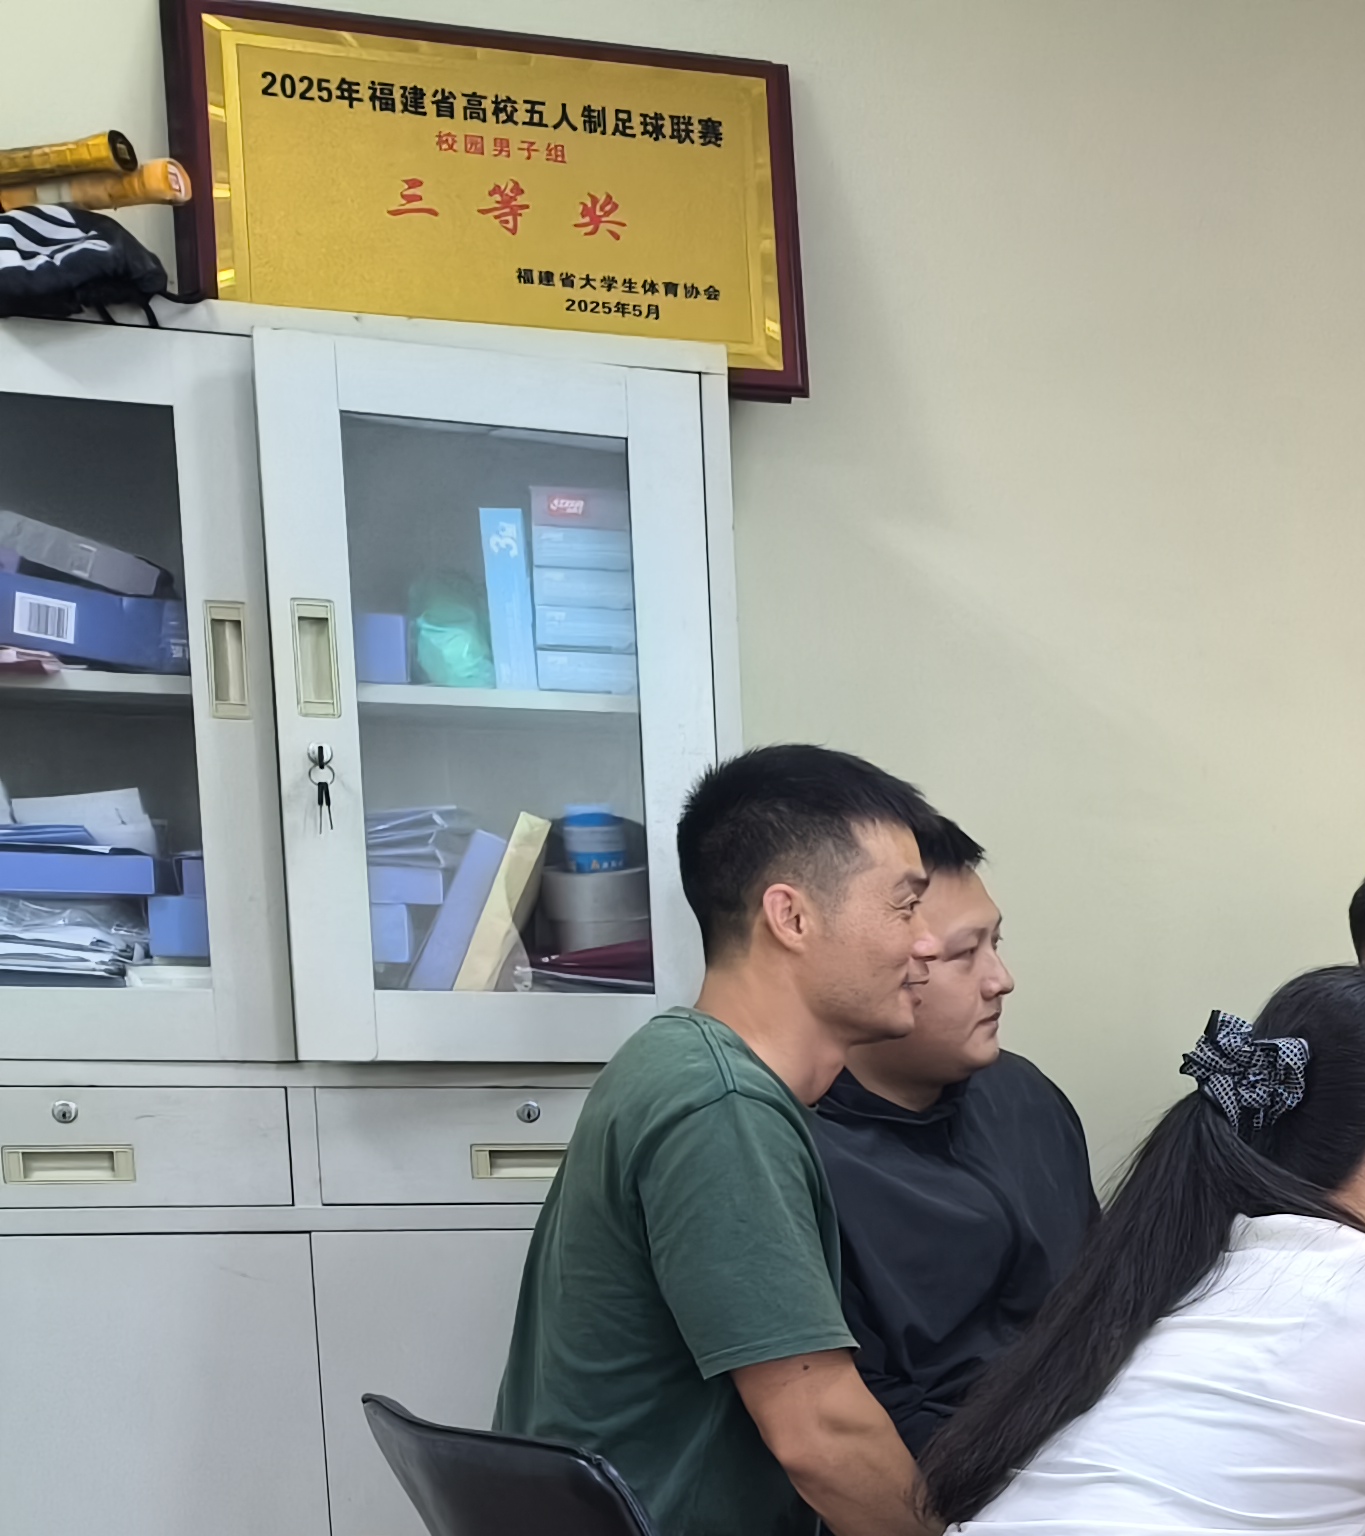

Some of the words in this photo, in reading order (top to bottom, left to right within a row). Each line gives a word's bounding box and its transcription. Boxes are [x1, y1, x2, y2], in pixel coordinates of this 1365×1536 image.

[261, 71, 723, 148] 2025年福建省高校五人制足球联赛
[435, 130, 568, 164] 校园男子组
[386, 177, 628, 241] 三等奖
[515, 267, 721, 301] 福建省大学生体育协会
[564, 298, 661, 321] 2025年5月
